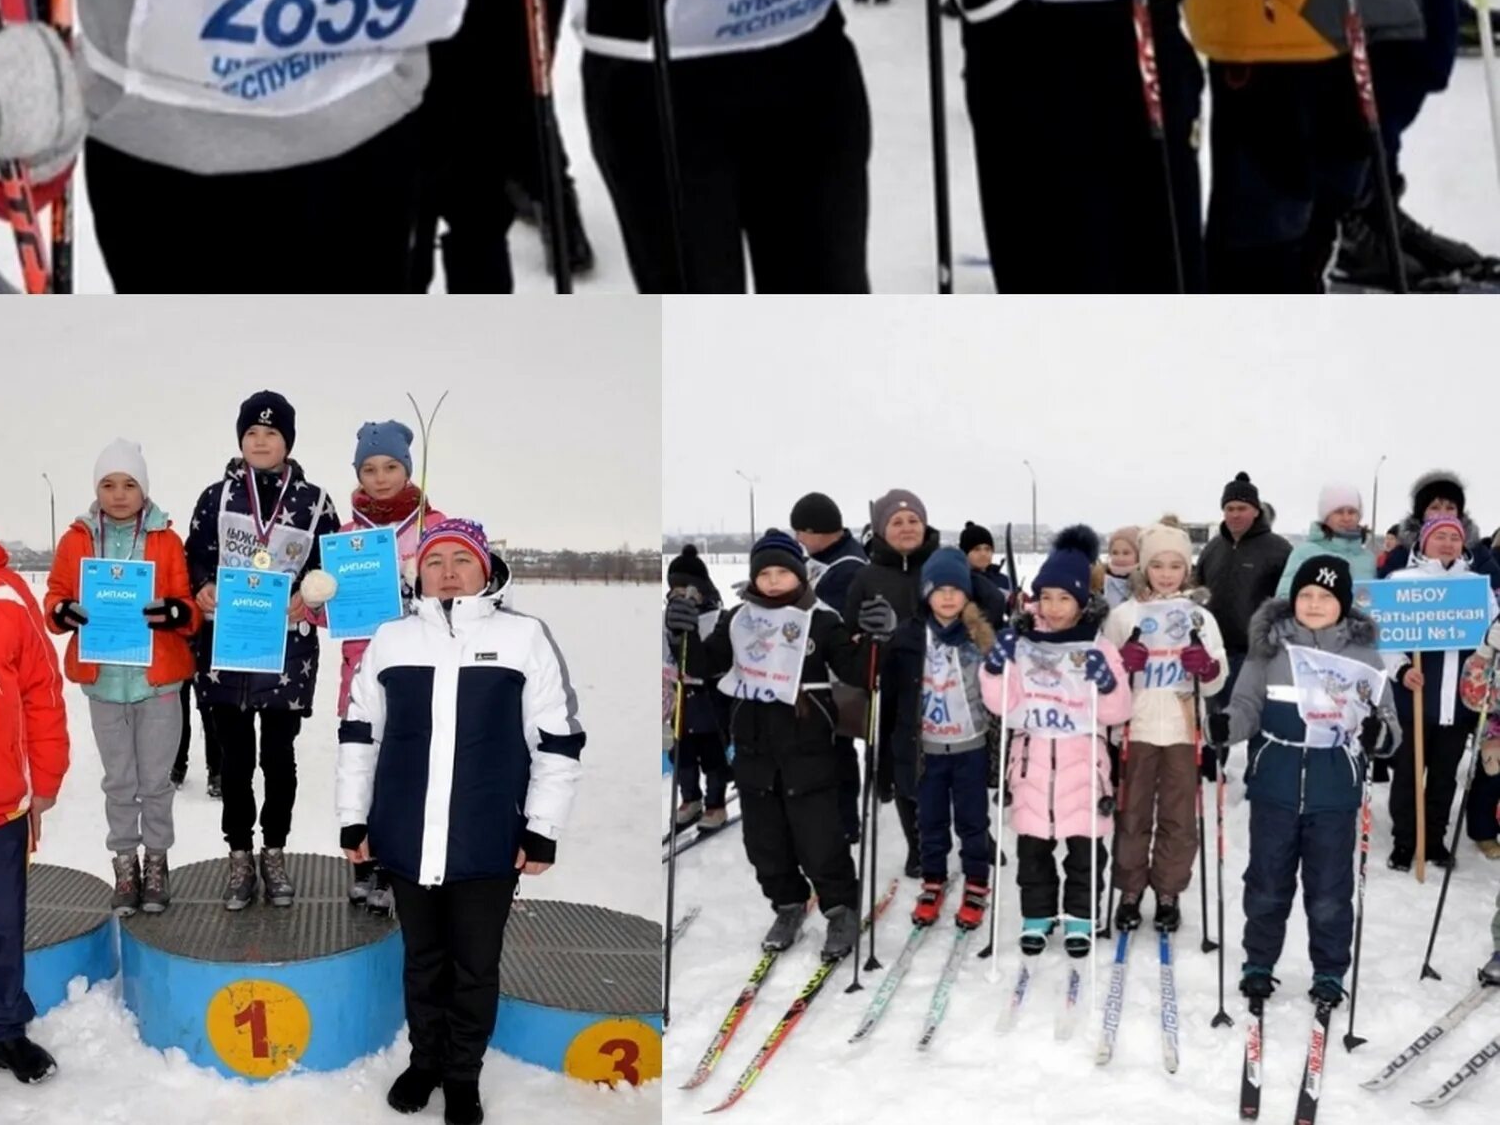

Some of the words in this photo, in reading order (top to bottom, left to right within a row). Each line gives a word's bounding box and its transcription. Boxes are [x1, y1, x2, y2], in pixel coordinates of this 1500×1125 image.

[338, 560, 381, 574] ДИПЛОМ
[1316, 567, 1338, 588] NY
[96, 590, 137, 600] ДИПЛОМ
[1395, 586, 1448, 603] МБОУ
[232, 598, 273, 609] ДИПЛОМ
[1369, 608, 1485, 626] Батыревская
[1379, 627, 1423, 643] СОШ
[1427, 626, 1467, 641] №1»
[233, 999, 270, 1060] 1
[1382, 1025, 1444, 1079] motor
[596, 1038, 641, 1089] 3
